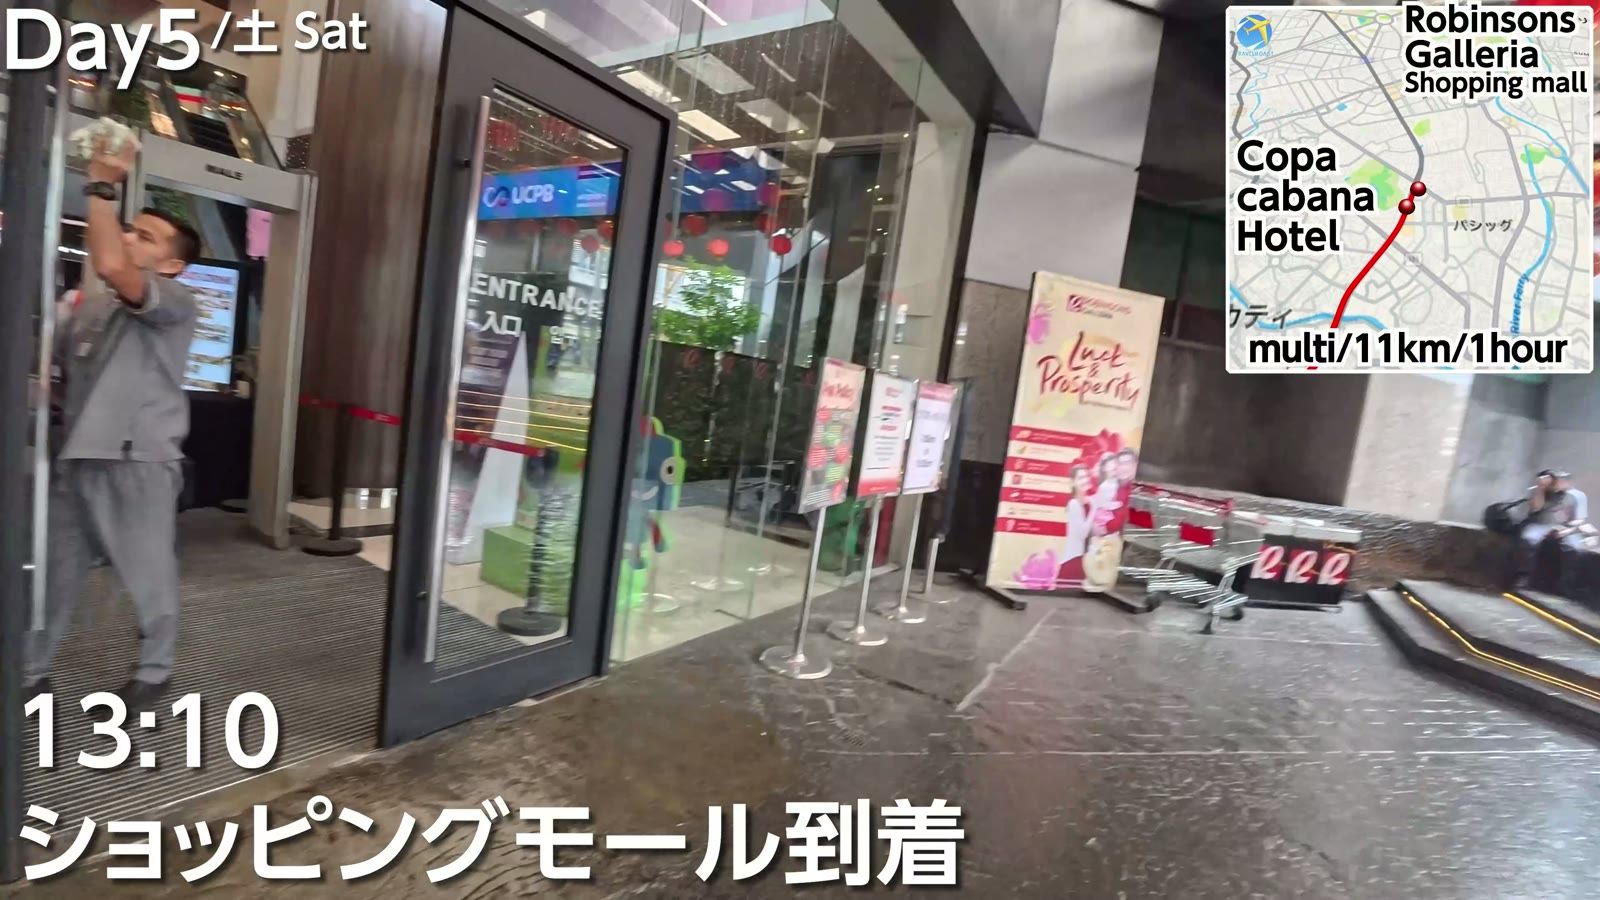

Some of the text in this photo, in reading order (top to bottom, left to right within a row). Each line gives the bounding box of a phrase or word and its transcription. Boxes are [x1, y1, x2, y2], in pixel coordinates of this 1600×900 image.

[511, 183, 555, 205] UCPB
[469, 272, 602, 320] ENTRANCE
[480, 310, 522, 337] 入口
[1067, 330, 1126, 371] Luck
[1036, 354, 1140, 411] Prosperity
